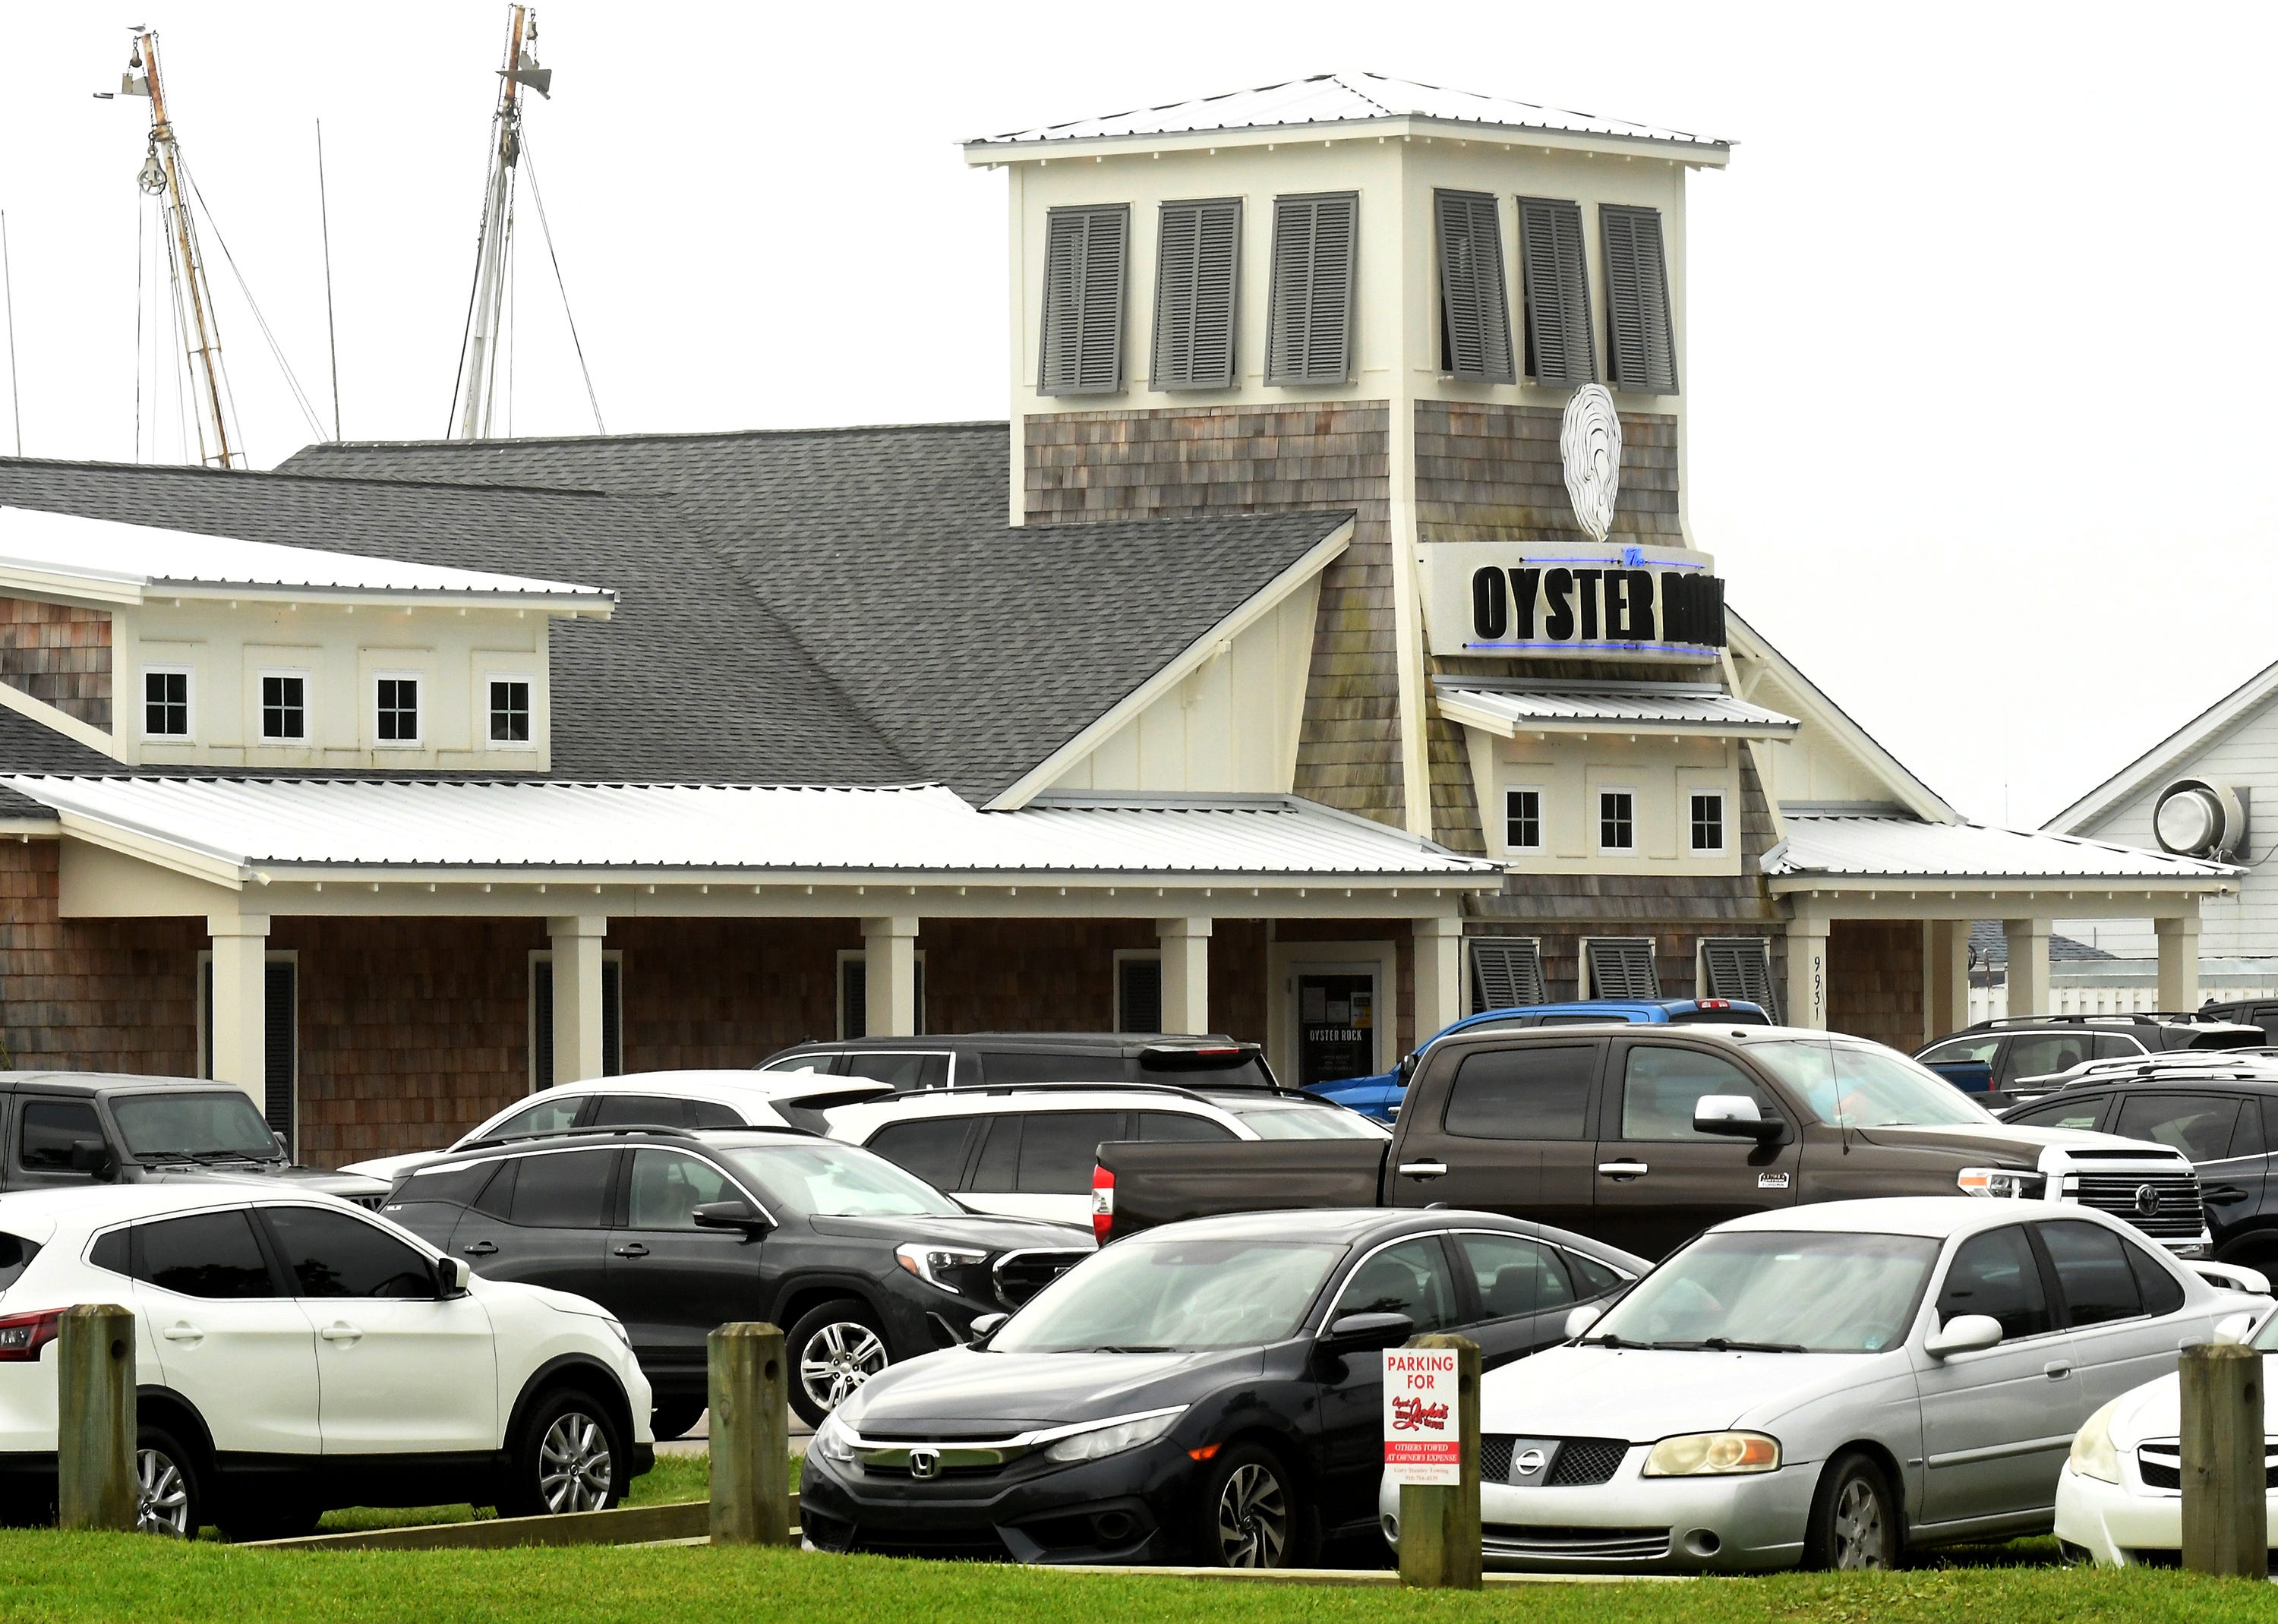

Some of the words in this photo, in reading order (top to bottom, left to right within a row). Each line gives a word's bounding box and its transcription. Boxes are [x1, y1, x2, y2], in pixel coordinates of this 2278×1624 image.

[1472, 566, 1656, 642] OYSTER
[1310, 1030, 1339, 1041] OYSTER
[1341, 1030, 1361, 1041] ROCK
[1388, 1357, 1453, 1371] PARKING
[1408, 1375, 1434, 1389] FOR
